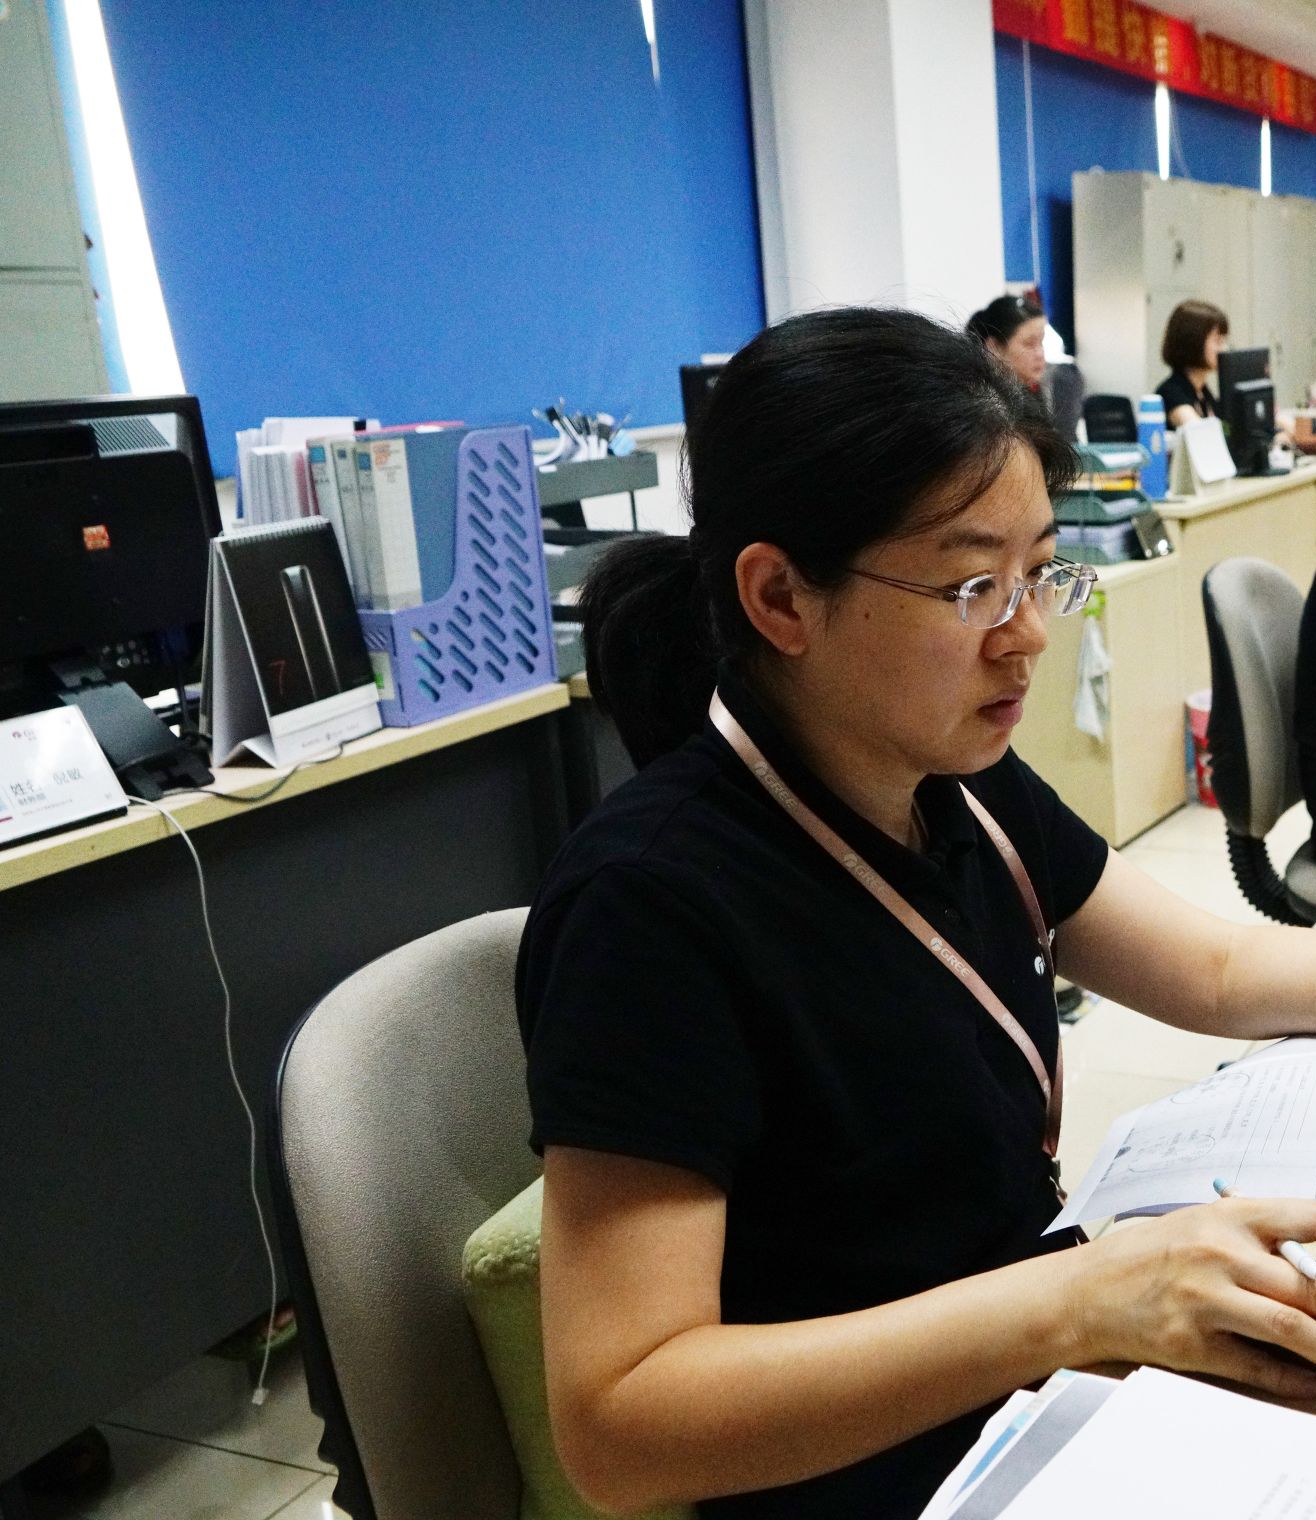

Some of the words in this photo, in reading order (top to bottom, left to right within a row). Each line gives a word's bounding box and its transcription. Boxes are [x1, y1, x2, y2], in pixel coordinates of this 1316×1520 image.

[764, 774, 797, 809] GREE
[855, 863, 891, 898] GREE
[940, 948, 971, 978] GREE
